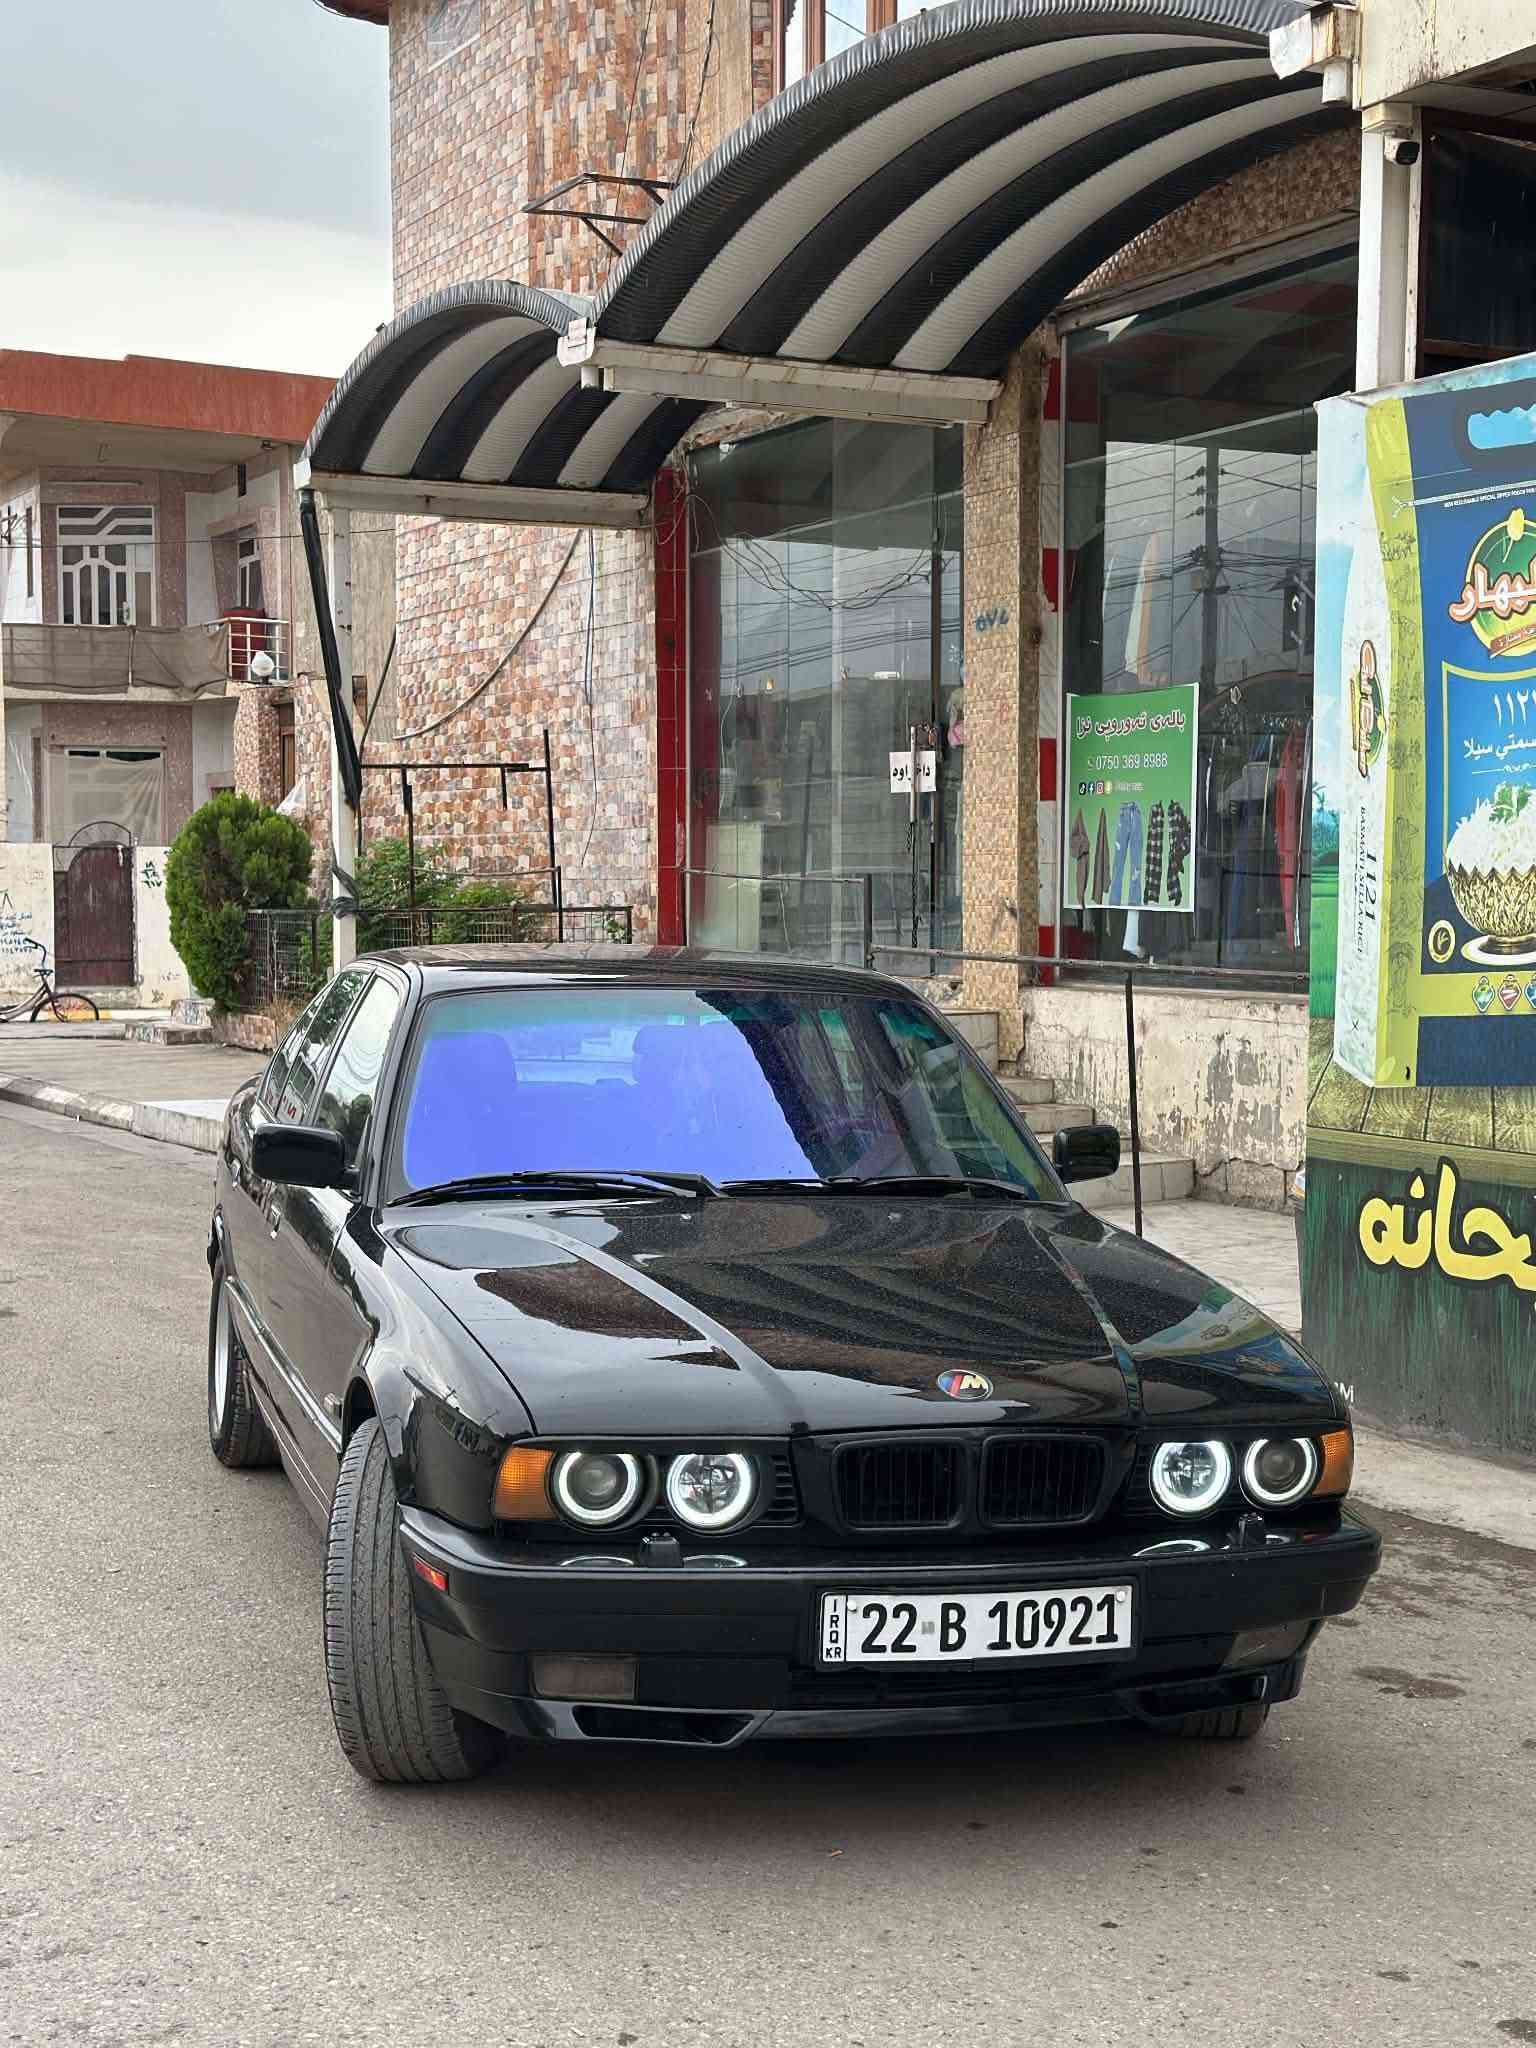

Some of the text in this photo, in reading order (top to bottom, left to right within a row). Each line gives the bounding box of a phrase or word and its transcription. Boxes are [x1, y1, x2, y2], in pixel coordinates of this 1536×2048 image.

[1449, 556, 1536, 622] بهار
[1365, 848, 1377, 922] 1121
[825, 1646, 842, 1659] KR
[861, 1593, 1118, 1654] 22 B 10921
